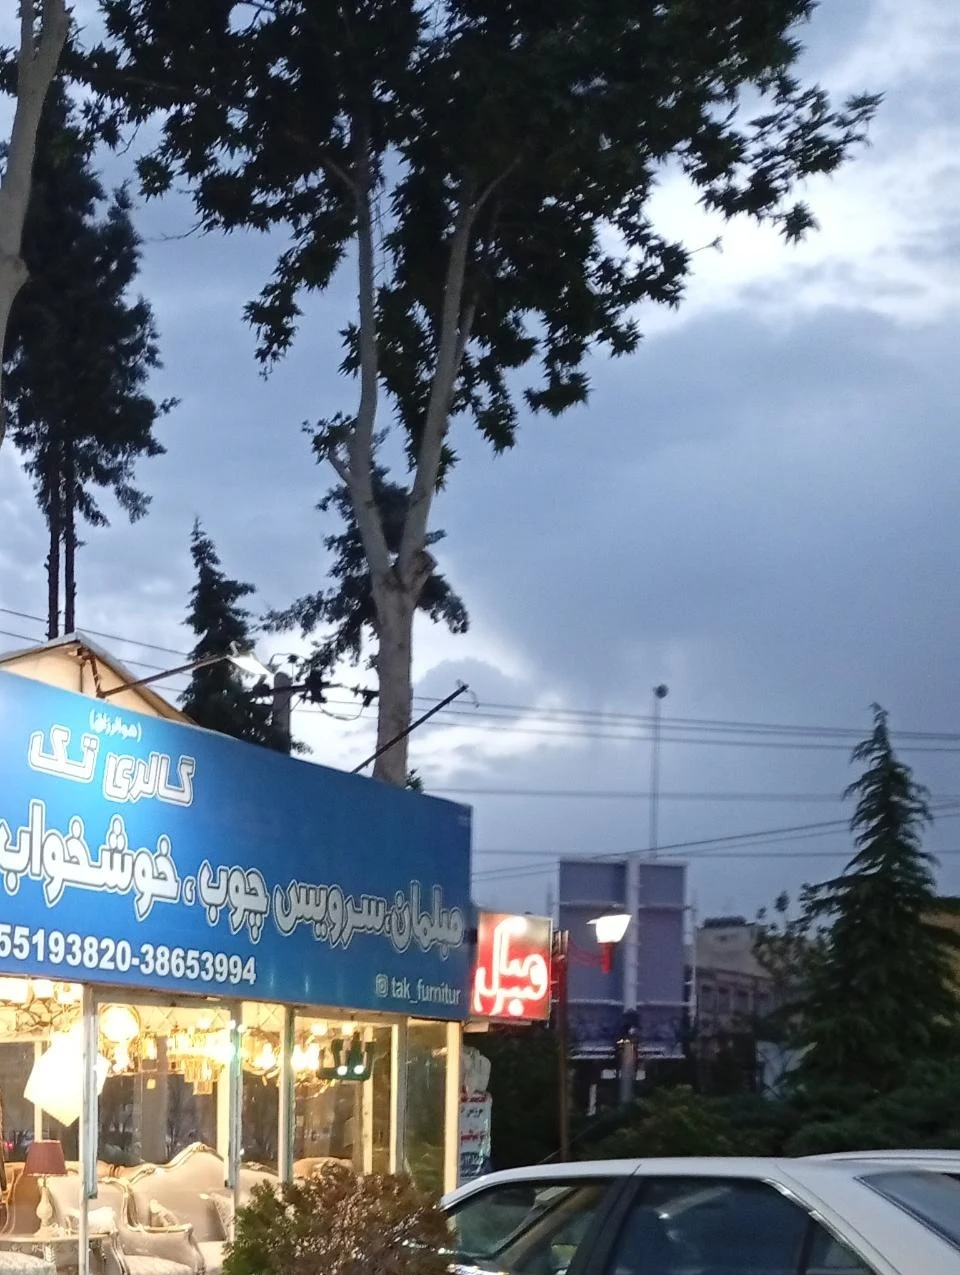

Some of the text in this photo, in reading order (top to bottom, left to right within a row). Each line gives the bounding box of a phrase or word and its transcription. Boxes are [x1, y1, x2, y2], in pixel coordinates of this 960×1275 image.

[28, 724, 196, 807] گالری تک
[273, 879, 386, 949] سرویس
